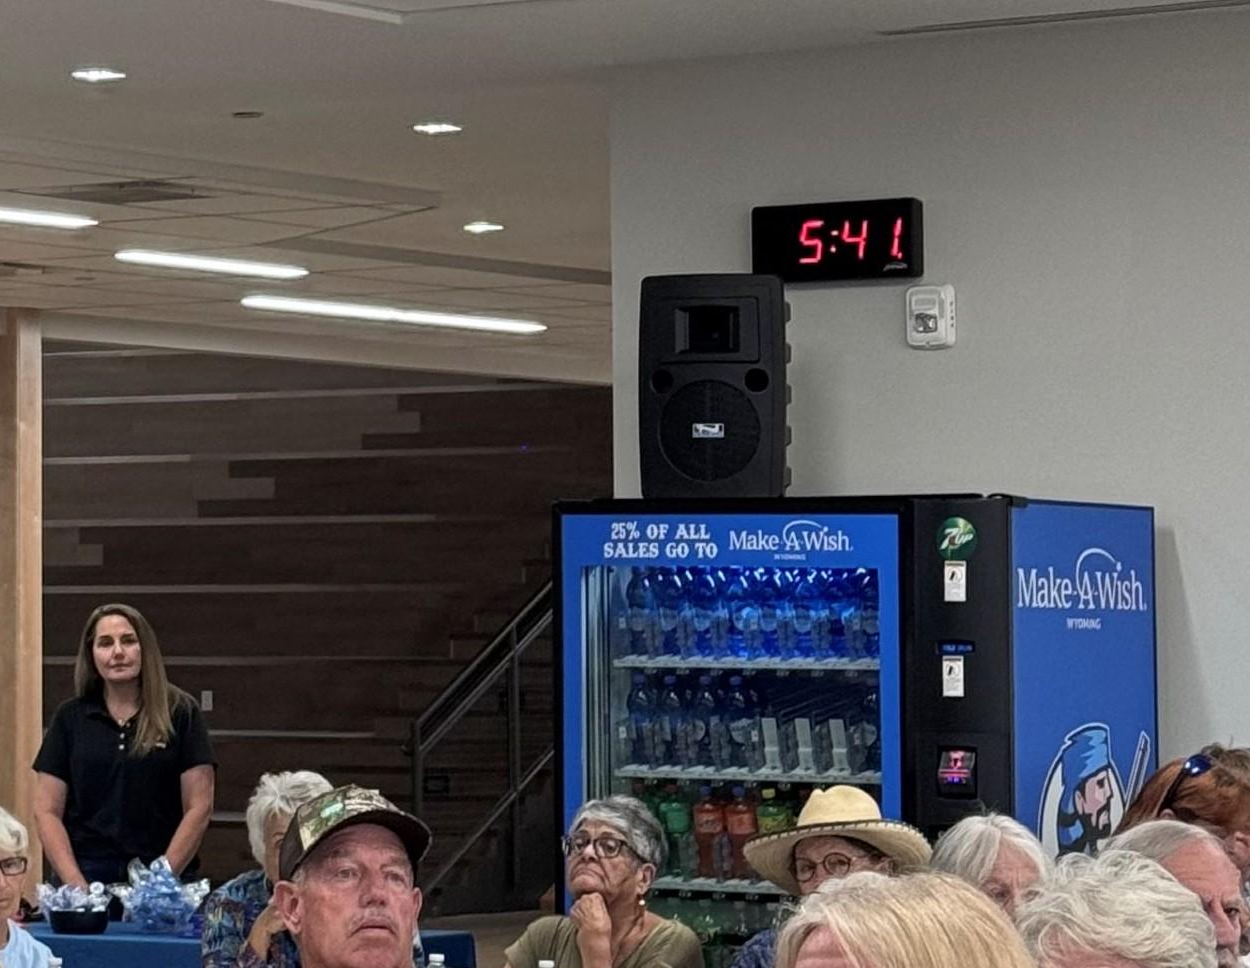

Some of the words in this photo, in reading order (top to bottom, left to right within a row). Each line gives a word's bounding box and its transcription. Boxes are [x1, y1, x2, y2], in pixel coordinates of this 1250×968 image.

[798, 217, 903, 264] 5:41
[610, 521, 640, 541] 25%
[646, 523, 669, 540] OF
[675, 523, 711, 540] ALL
[603, 542, 660, 559] SALES
[665, 542, 690, 559] GO
[694, 542, 719, 559] TO
[1066, 617, 1102, 630] WYOMING
